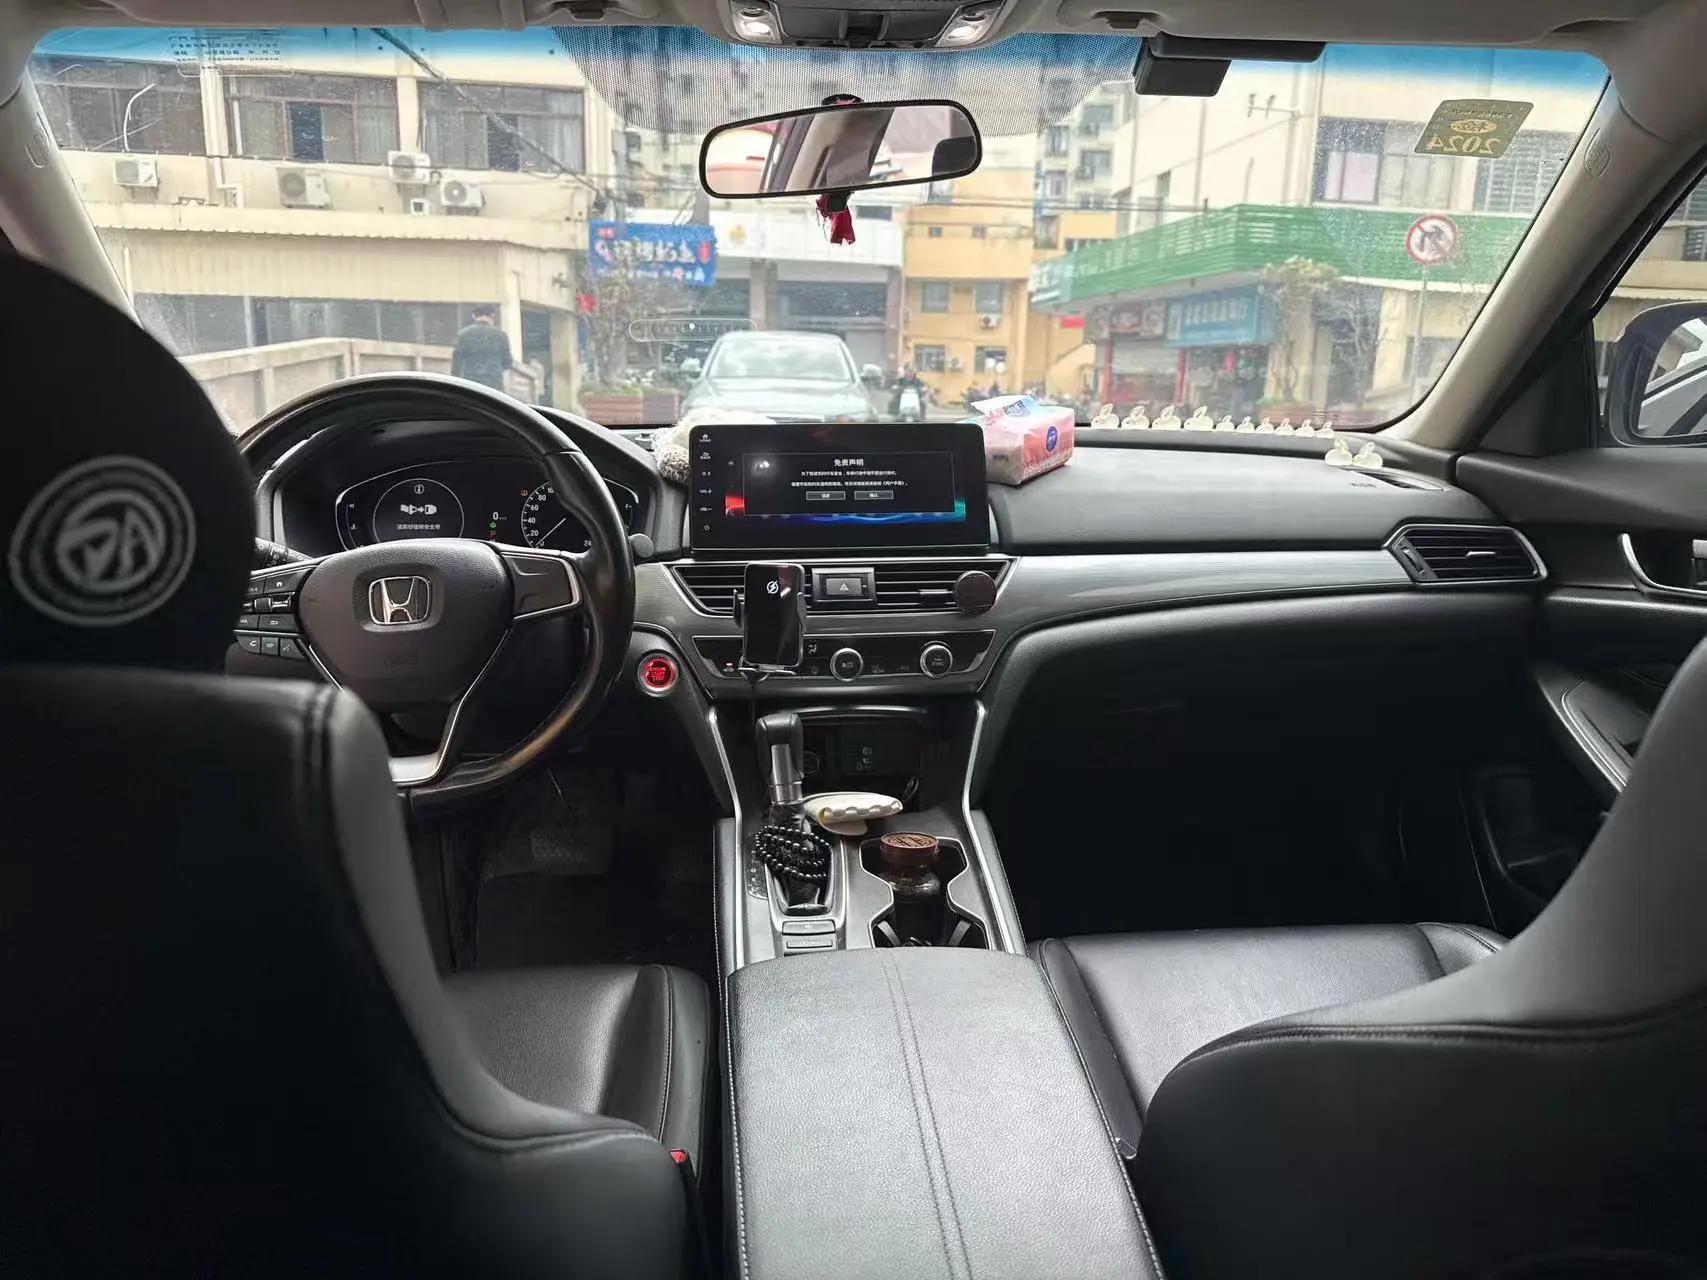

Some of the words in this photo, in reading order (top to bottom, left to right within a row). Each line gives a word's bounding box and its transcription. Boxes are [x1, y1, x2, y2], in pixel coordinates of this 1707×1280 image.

[833, 458, 864, 467] 免责声明
[492, 511, 499, 521] 0
